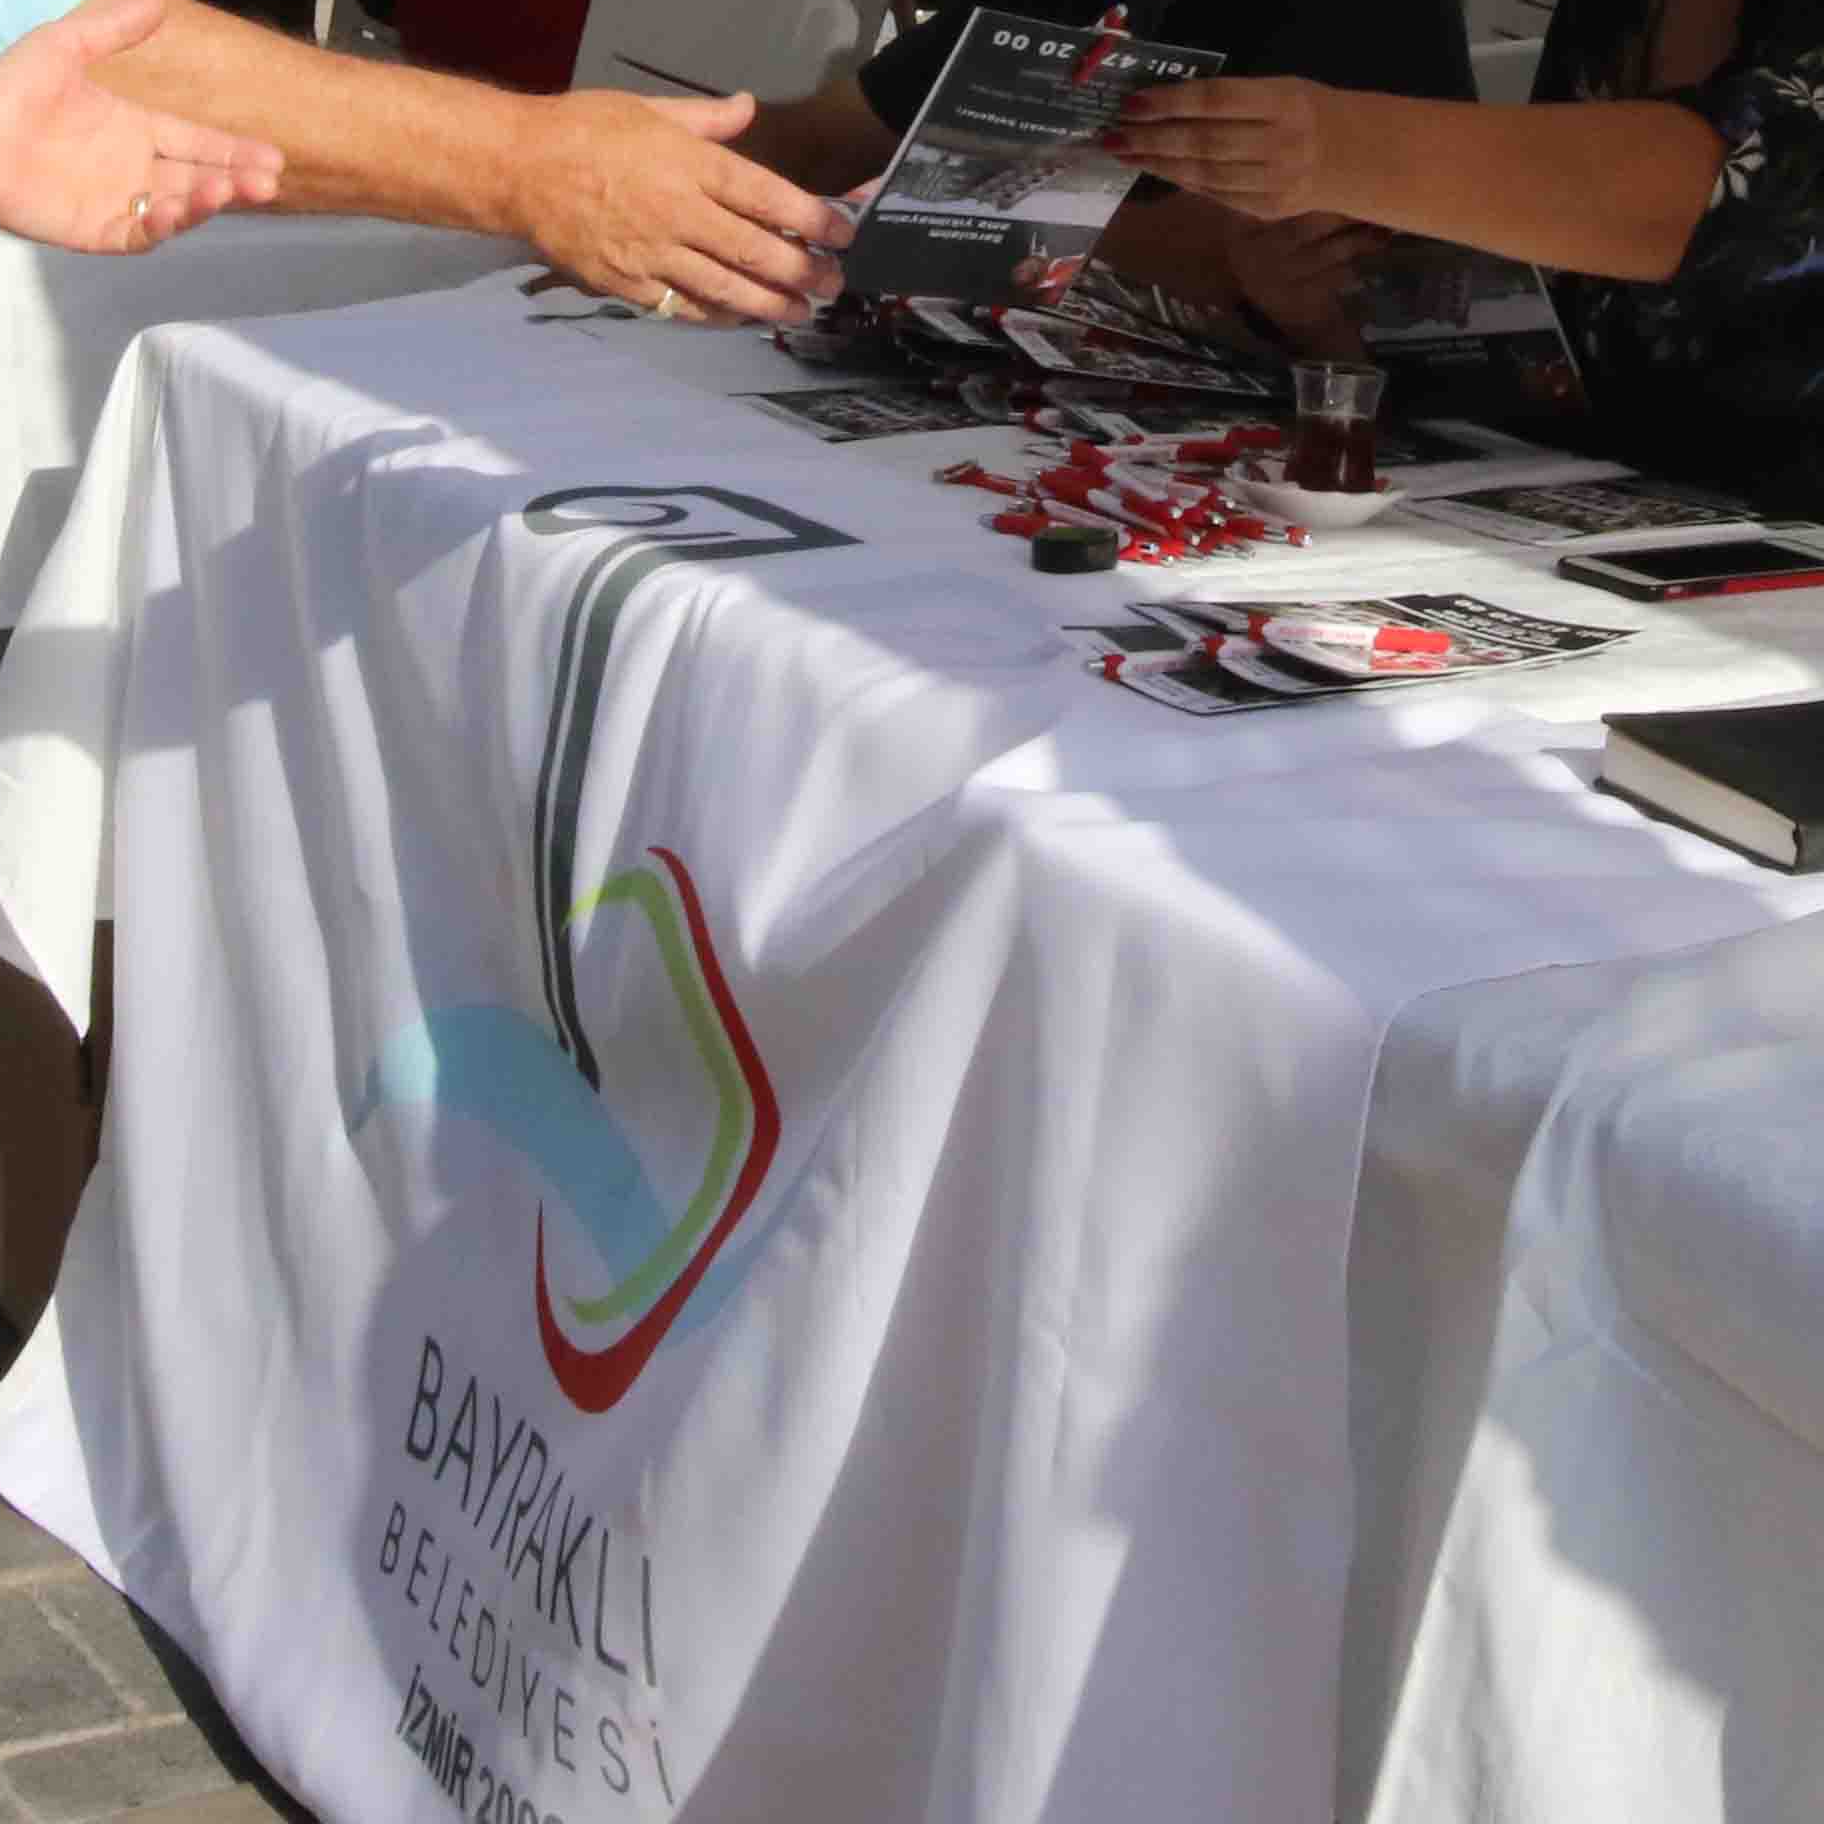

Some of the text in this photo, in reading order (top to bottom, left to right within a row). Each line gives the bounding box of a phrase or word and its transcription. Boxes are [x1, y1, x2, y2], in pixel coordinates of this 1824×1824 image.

[992, 30, 1031, 52] 00
[1039, 39, 1076, 59] 20
[404, 1335, 657, 1688] BAYRAKLI
[378, 1500, 674, 1805] BELEDİYESİ
[393, 1663, 474, 1813] İZMİR
